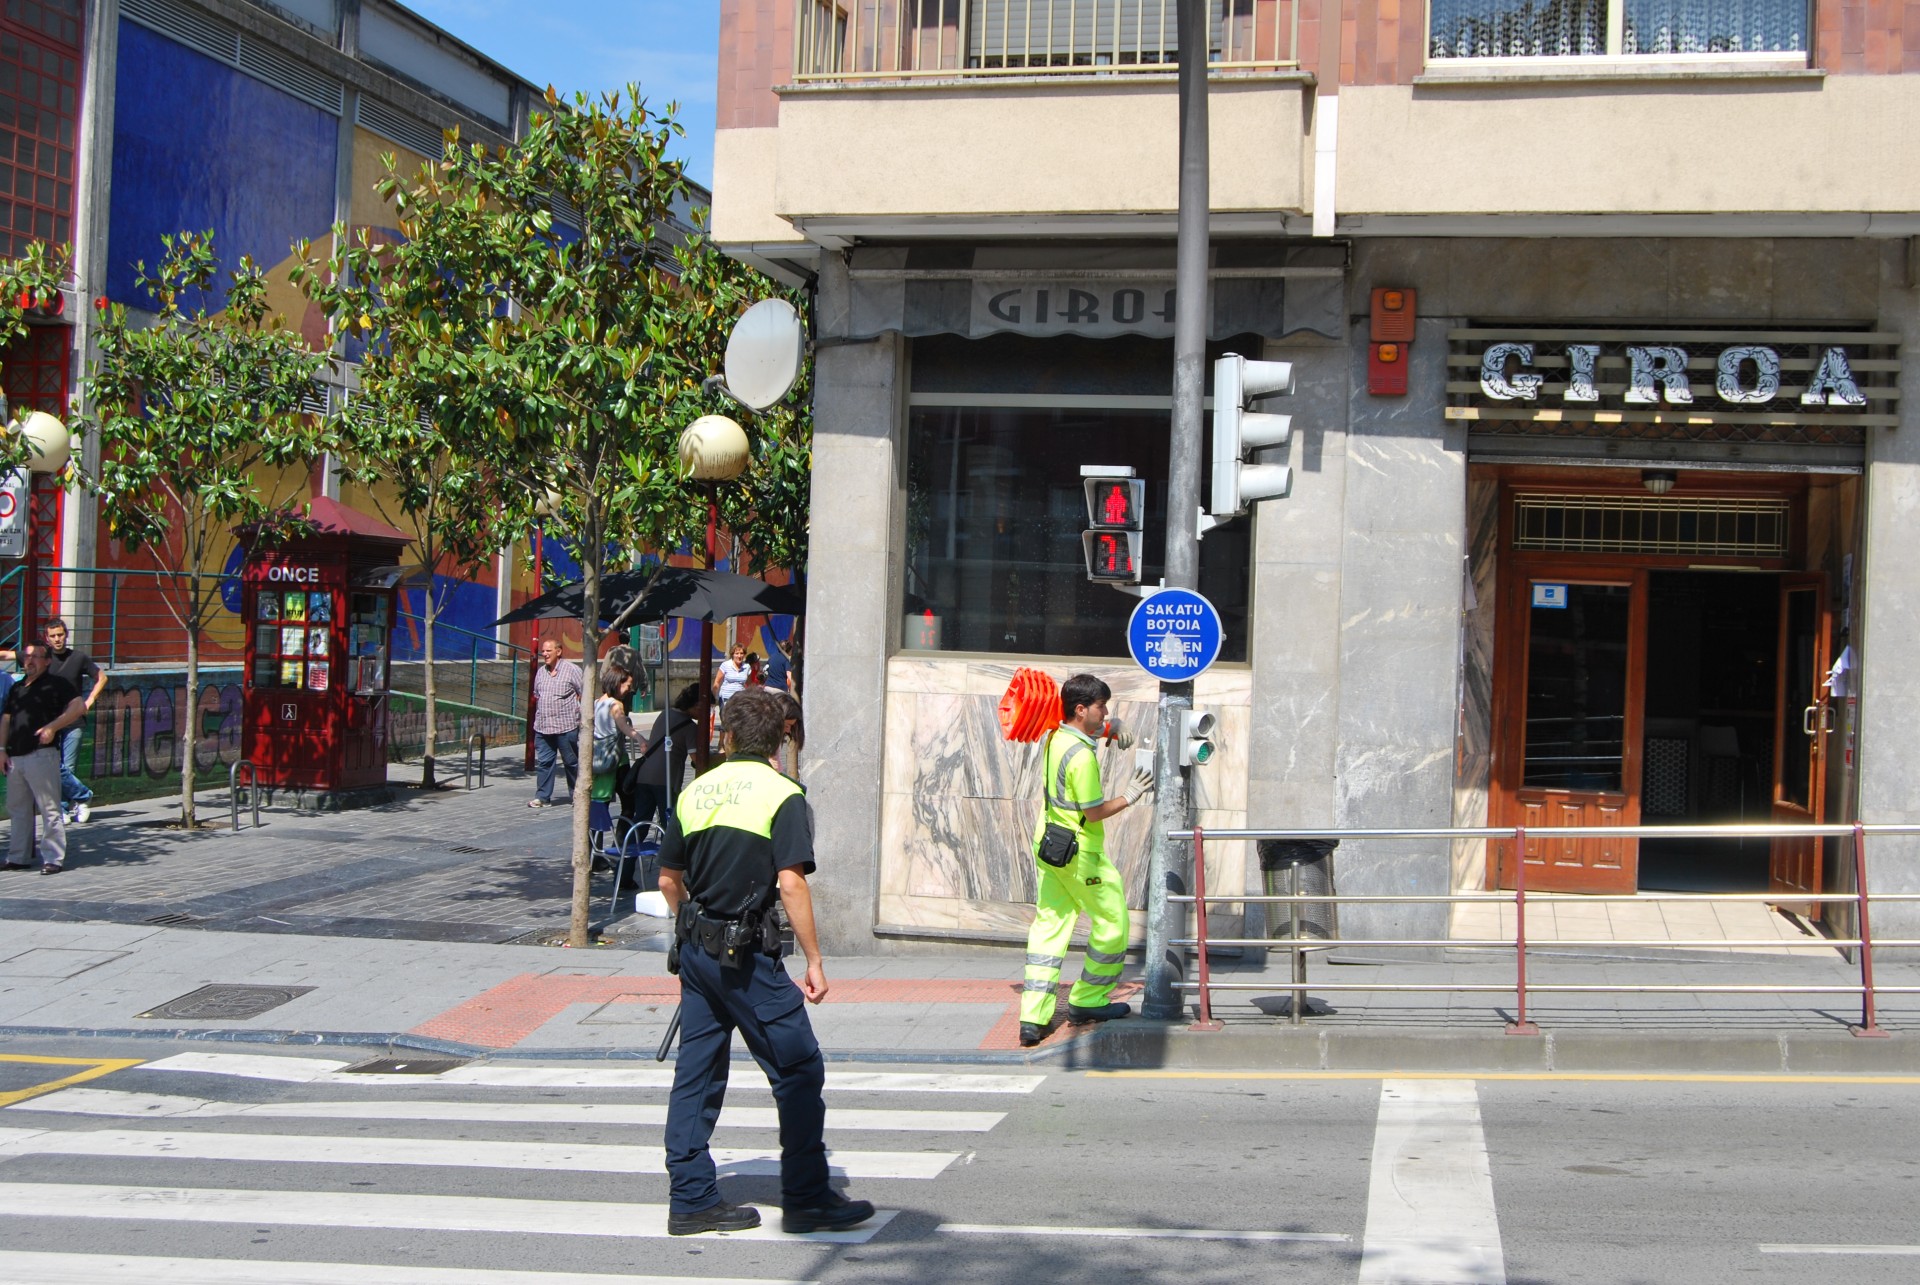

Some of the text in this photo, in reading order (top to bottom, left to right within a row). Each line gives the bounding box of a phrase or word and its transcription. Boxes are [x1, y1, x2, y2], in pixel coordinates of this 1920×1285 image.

[1480, 342, 1867, 406] GIROA
[268, 567, 319, 583] ONCE
[1146, 604, 1203, 616] SAKATU
[1147, 619, 1201, 631] BOTOIA
